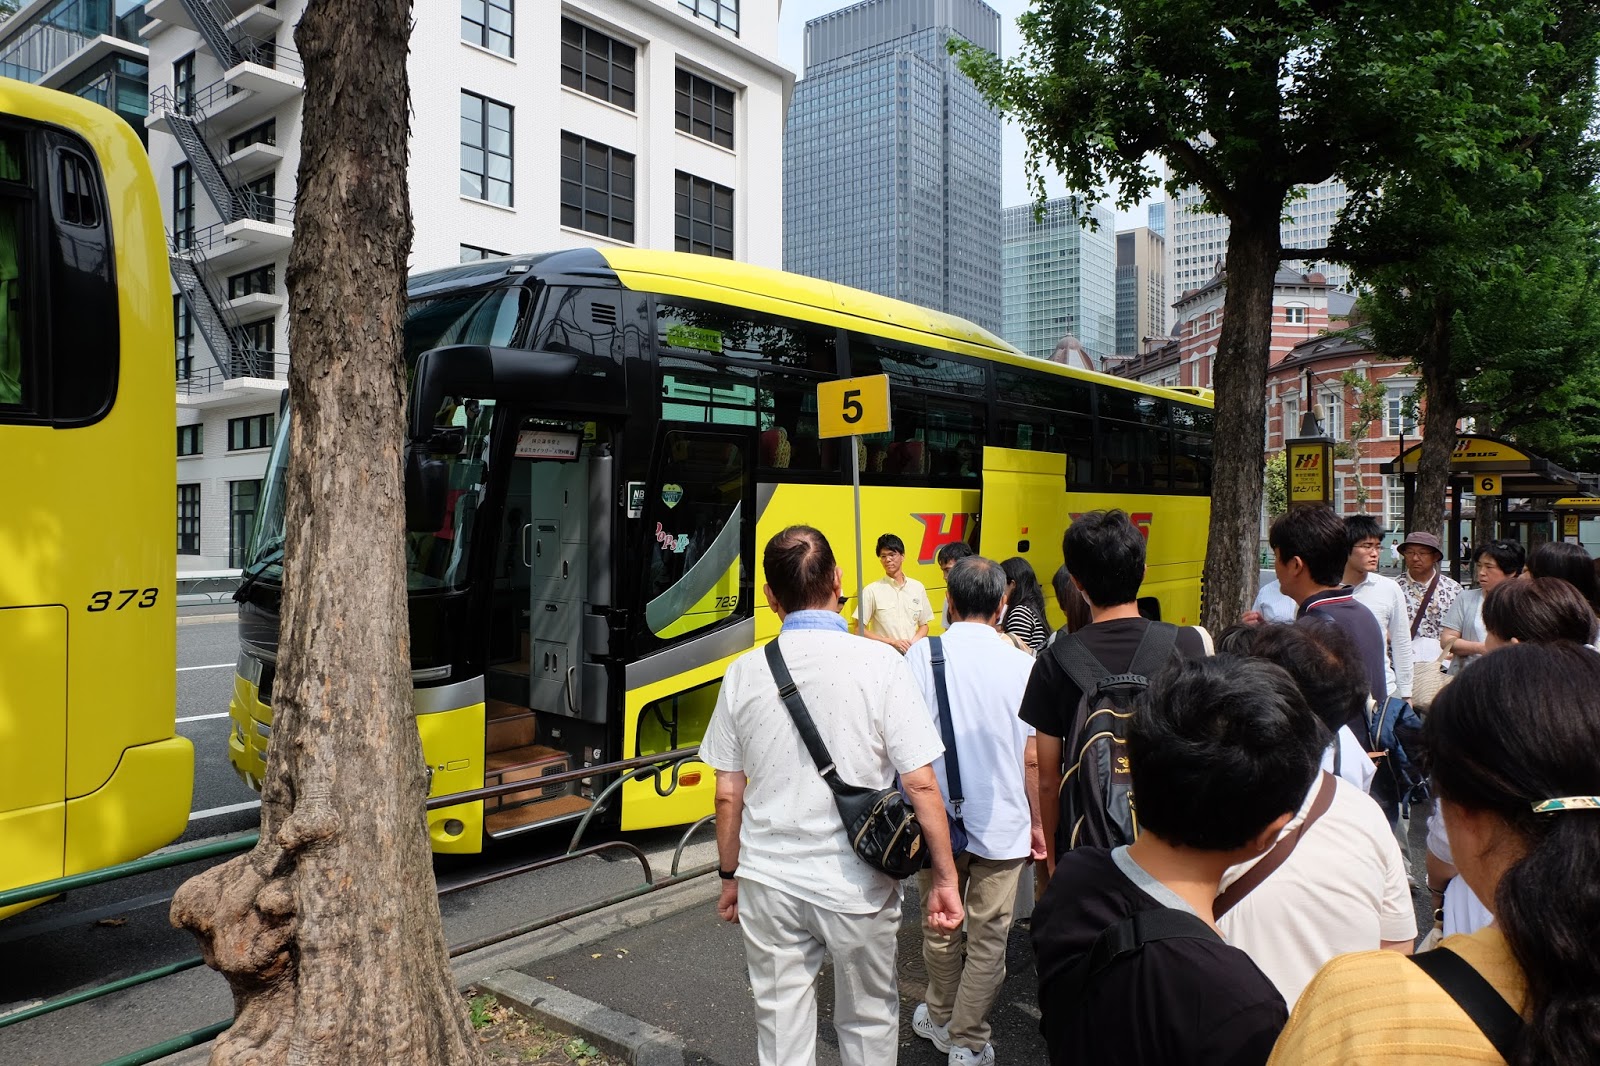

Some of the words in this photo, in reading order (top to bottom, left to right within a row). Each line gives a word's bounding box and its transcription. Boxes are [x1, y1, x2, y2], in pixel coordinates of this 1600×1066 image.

[841, 389, 863, 425] 5
[1293, 485, 1321, 493] はとバス
[1481, 477, 1494, 491] 6
[86, 587, 159, 613] 373
[715, 596, 738, 608] 723
